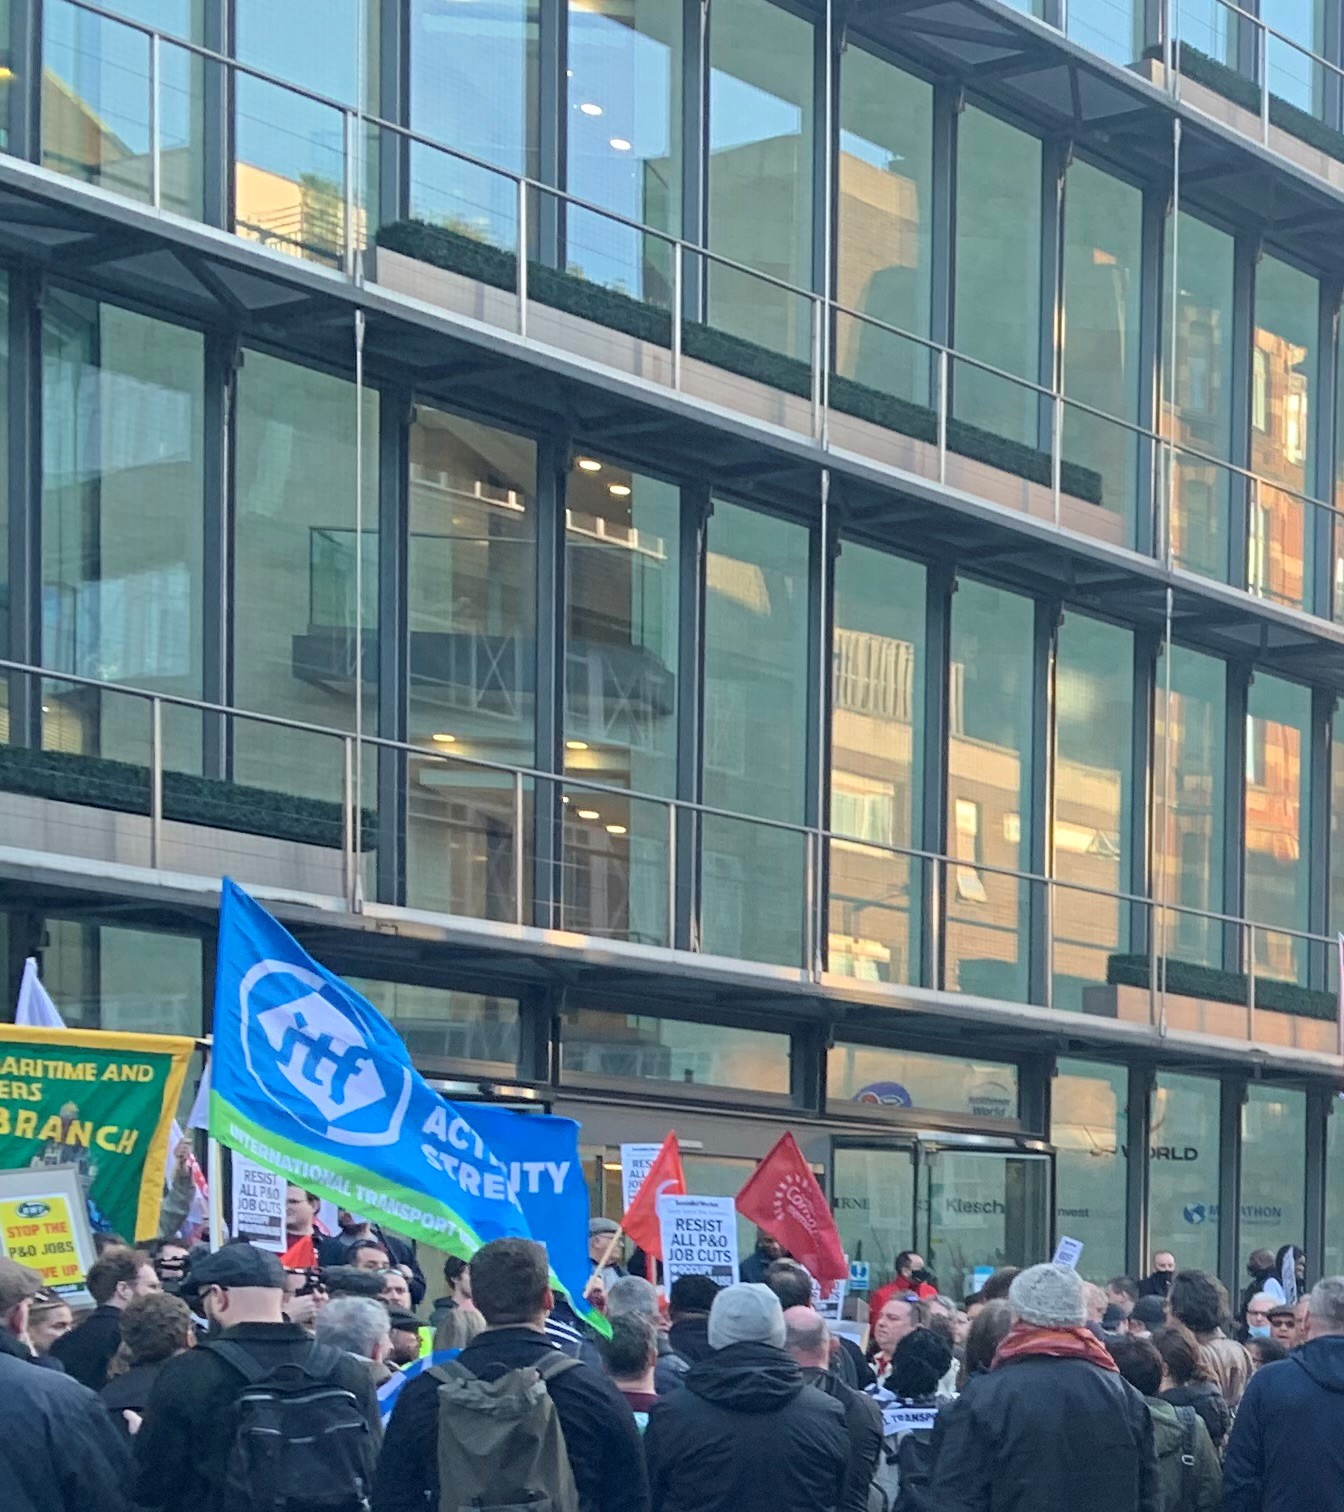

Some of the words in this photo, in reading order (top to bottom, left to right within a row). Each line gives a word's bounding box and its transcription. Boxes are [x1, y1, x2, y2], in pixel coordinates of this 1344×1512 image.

[278, 1012, 372, 1106] itf
[101, 1063, 155, 1083] AND
[244, 1169, 277, 1186] RESIST
[240, 1184, 257, 1197] ALL
[260, 1186, 280, 1200] P&O
[237, 1198, 257, 1212] JOB
[259, 1201, 282, 1215] CUTS
[1057, 1208, 1089, 1217] nvest
[1209, 1205, 1282, 1217] MATHON
[6, 1224, 40, 1239] STOP
[43, 1222, 67, 1234] THE
[676, 1218, 722, 1233] RESIST
[671, 1233, 695, 1247] ALL
[699, 1234, 728, 1248] P&O
[42, 1241, 75, 1256] JOBS
[668, 1248, 694, 1262] JOB
[698, 1250, 732, 1263] CUTS
[62, 1265, 78, 1277] UP
